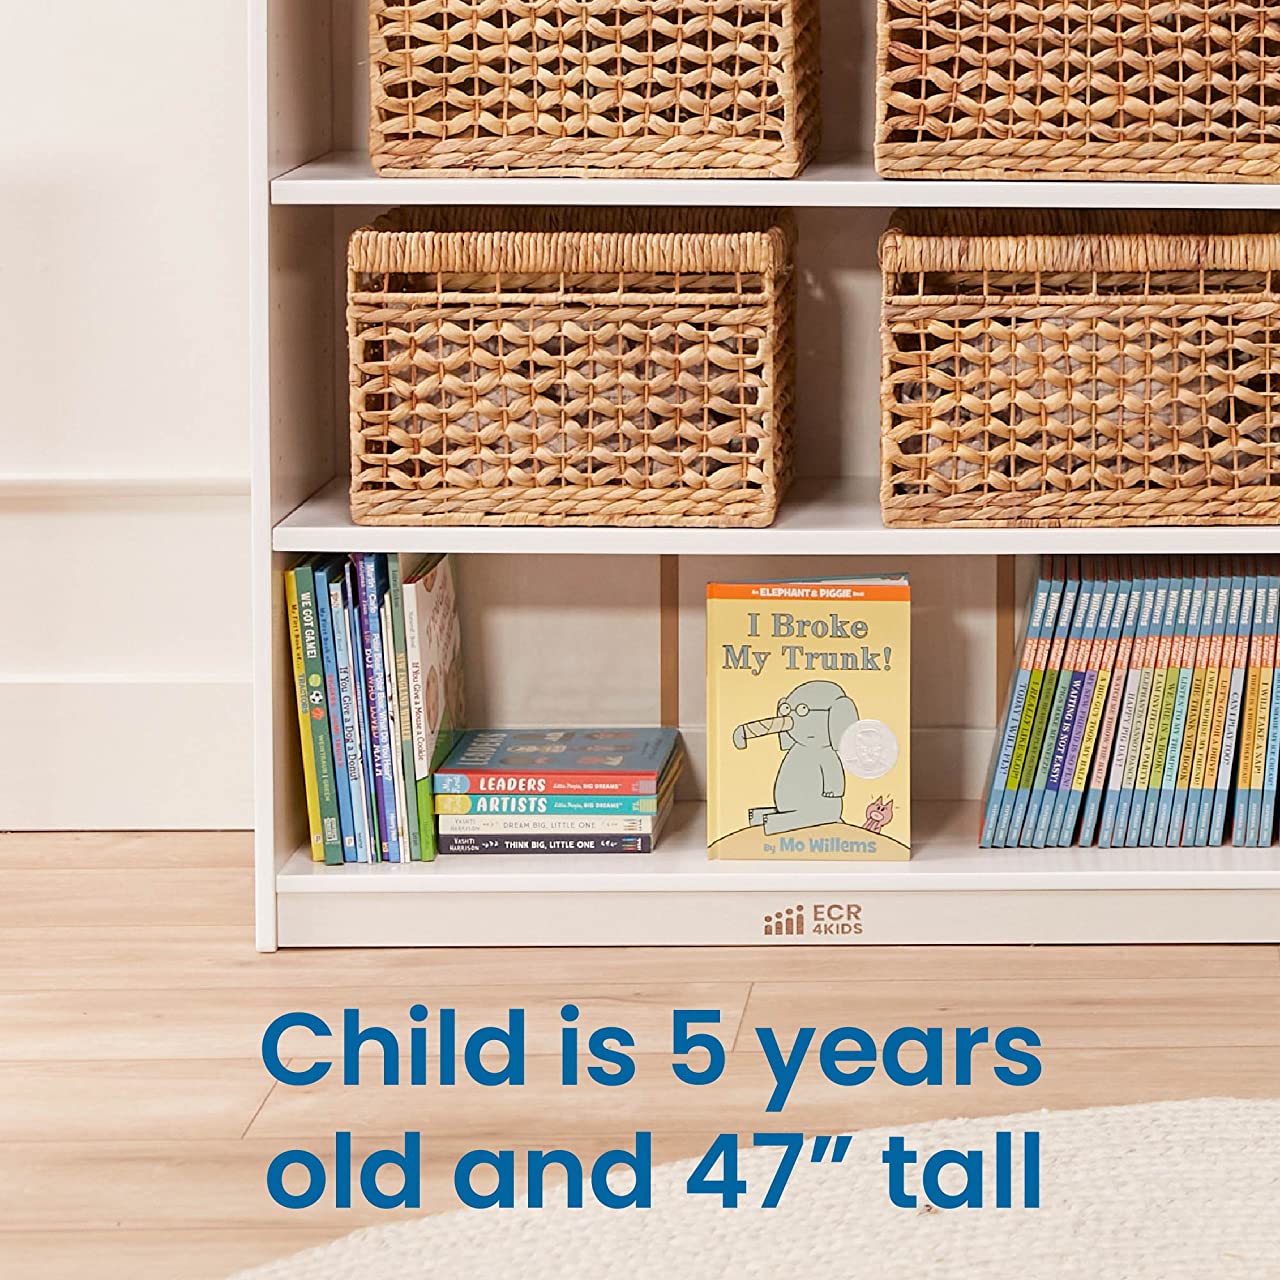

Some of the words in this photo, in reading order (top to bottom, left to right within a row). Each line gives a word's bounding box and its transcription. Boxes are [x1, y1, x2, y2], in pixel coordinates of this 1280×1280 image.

[366, 564, 376, 588] Martin
[300, 591, 311, 606] WE
[368, 593, 378, 613] Carle
[820, 589, 851, 598] PIGGIE
[302, 608, 313, 627] GOT
[1127, 591, 1140, 625] Willems
[1203, 590, 1217, 625] Willems
[748, 613, 760, 636] I
[771, 613, 868, 638] Broke
[304, 629, 316, 658] GAME!
[372, 633, 382, 651] Polar
[339, 666, 348, 674] If
[395, 651, 406, 669] NEW
[722, 645, 771, 675] My
[782, 646, 891, 671] Trunk!
[339, 676, 350, 692] You
[375, 672, 385, 691] Polar
[412, 669, 420, 682] You
[297, 673, 309, 713] TRACTORS
[397, 672, 409, 705] ENGLAND
[413, 684, 422, 698] Give
[1192, 677, 1202, 696] THE
[341, 695, 352, 715] Give
[1014, 683, 1027, 712] TODAY
[1064, 680, 1081, 720] WAITING
[1123, 692, 1135, 723] HAPPY
[1259, 688, 1268, 712] WILL
[378, 711, 388, 729] What
[399, 707, 412, 740] WHALER
[415, 706, 424, 729] Mouse
[1187, 700, 1199, 730] THANK
[344, 725, 355, 743] Dog
[380, 730, 389, 742] Do
[1005, 725, 1017, 750] WILL
[1120, 726, 1129, 741] PIG
[1256, 715, 1265, 741] TAKE
[381, 744, 390, 758] You
[417, 736, 426, 760] Cookie
[1056, 733, 1068, 753] NOT
[1183, 734, 1193, 753] YOU
[999, 753, 1011, 774] FLY!
[1115, 744, 1125, 767] DAY!
[1253, 752, 1262, 773] NAP!
[347, 753, 359, 781] Donut
[382, 759, 392, 781] Hear?
[1049, 755, 1063, 782] EASY!
[1179, 755, 1190, 781] BOOK
[480, 778, 546, 792] LEADERS
[476, 797, 547, 813] ARTISTS
[532, 822, 549, 830] BIG,
[532, 841, 547, 849] BIG,
[764, 843, 776, 854] By
[780, 837, 805, 852] Mo
[810, 838, 877, 853] Willems
[813, 904, 862, 921] ECR
[812, 923, 863, 934] 4KIDS
